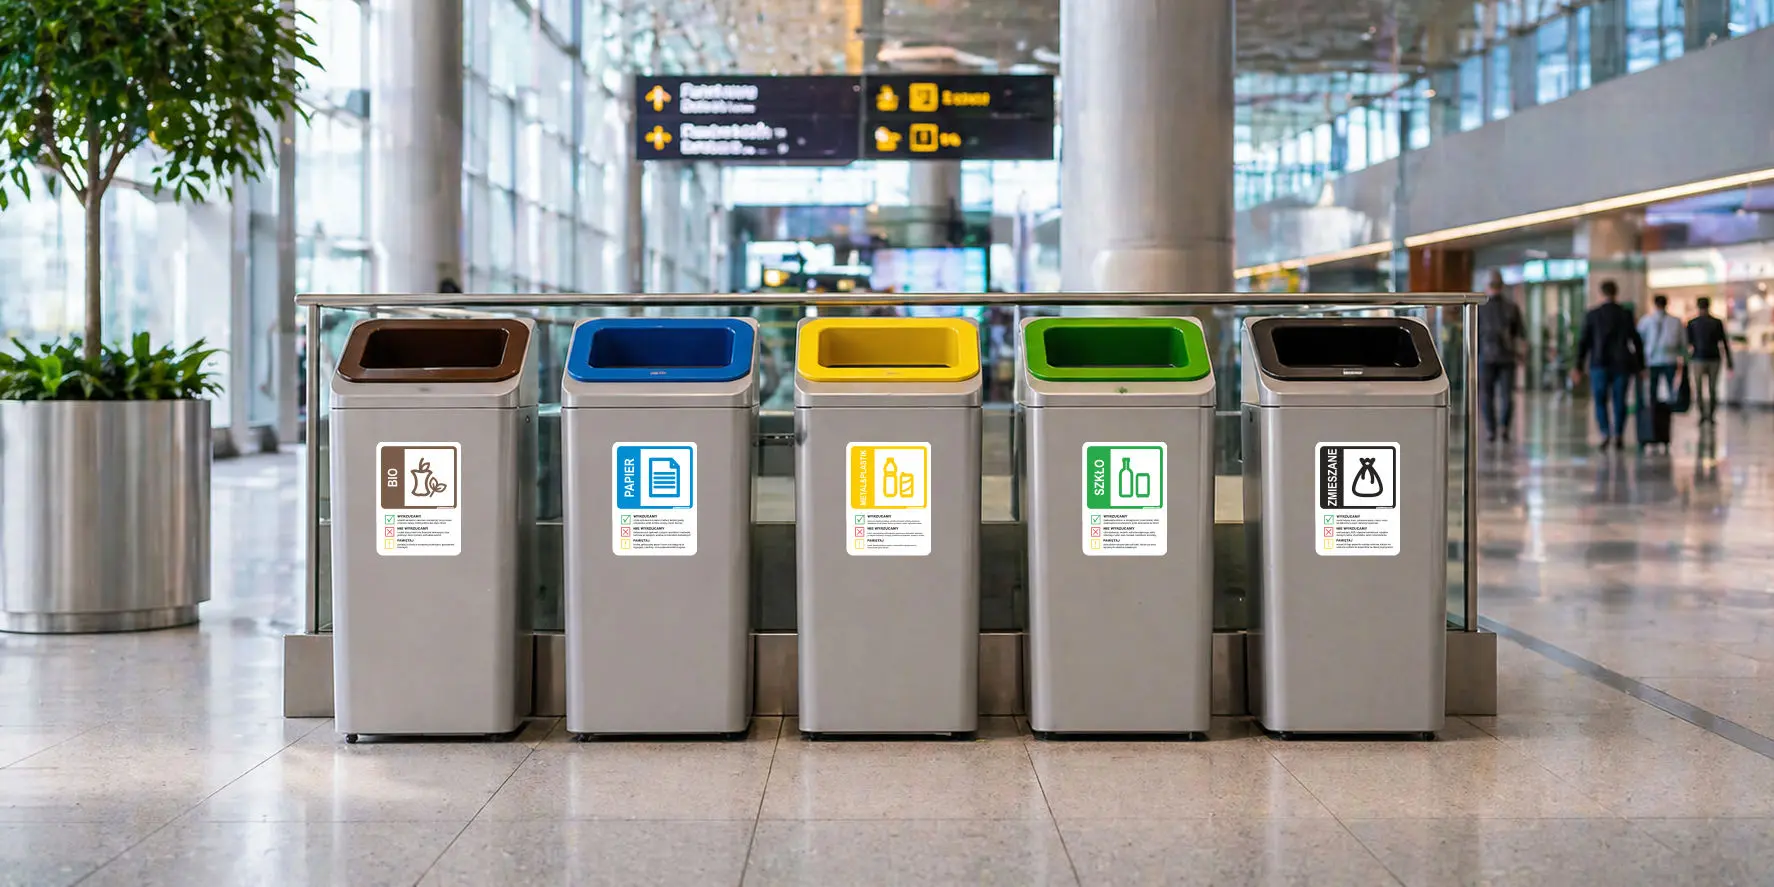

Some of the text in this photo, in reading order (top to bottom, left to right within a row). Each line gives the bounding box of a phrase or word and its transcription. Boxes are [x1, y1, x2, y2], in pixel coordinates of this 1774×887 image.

[387, 468, 398, 487] BIO
[624, 458, 635, 498] PAPIER
[1094, 459, 1105, 496] SZKŁO
[1327, 448, 1338, 507] ZMIESZANE
